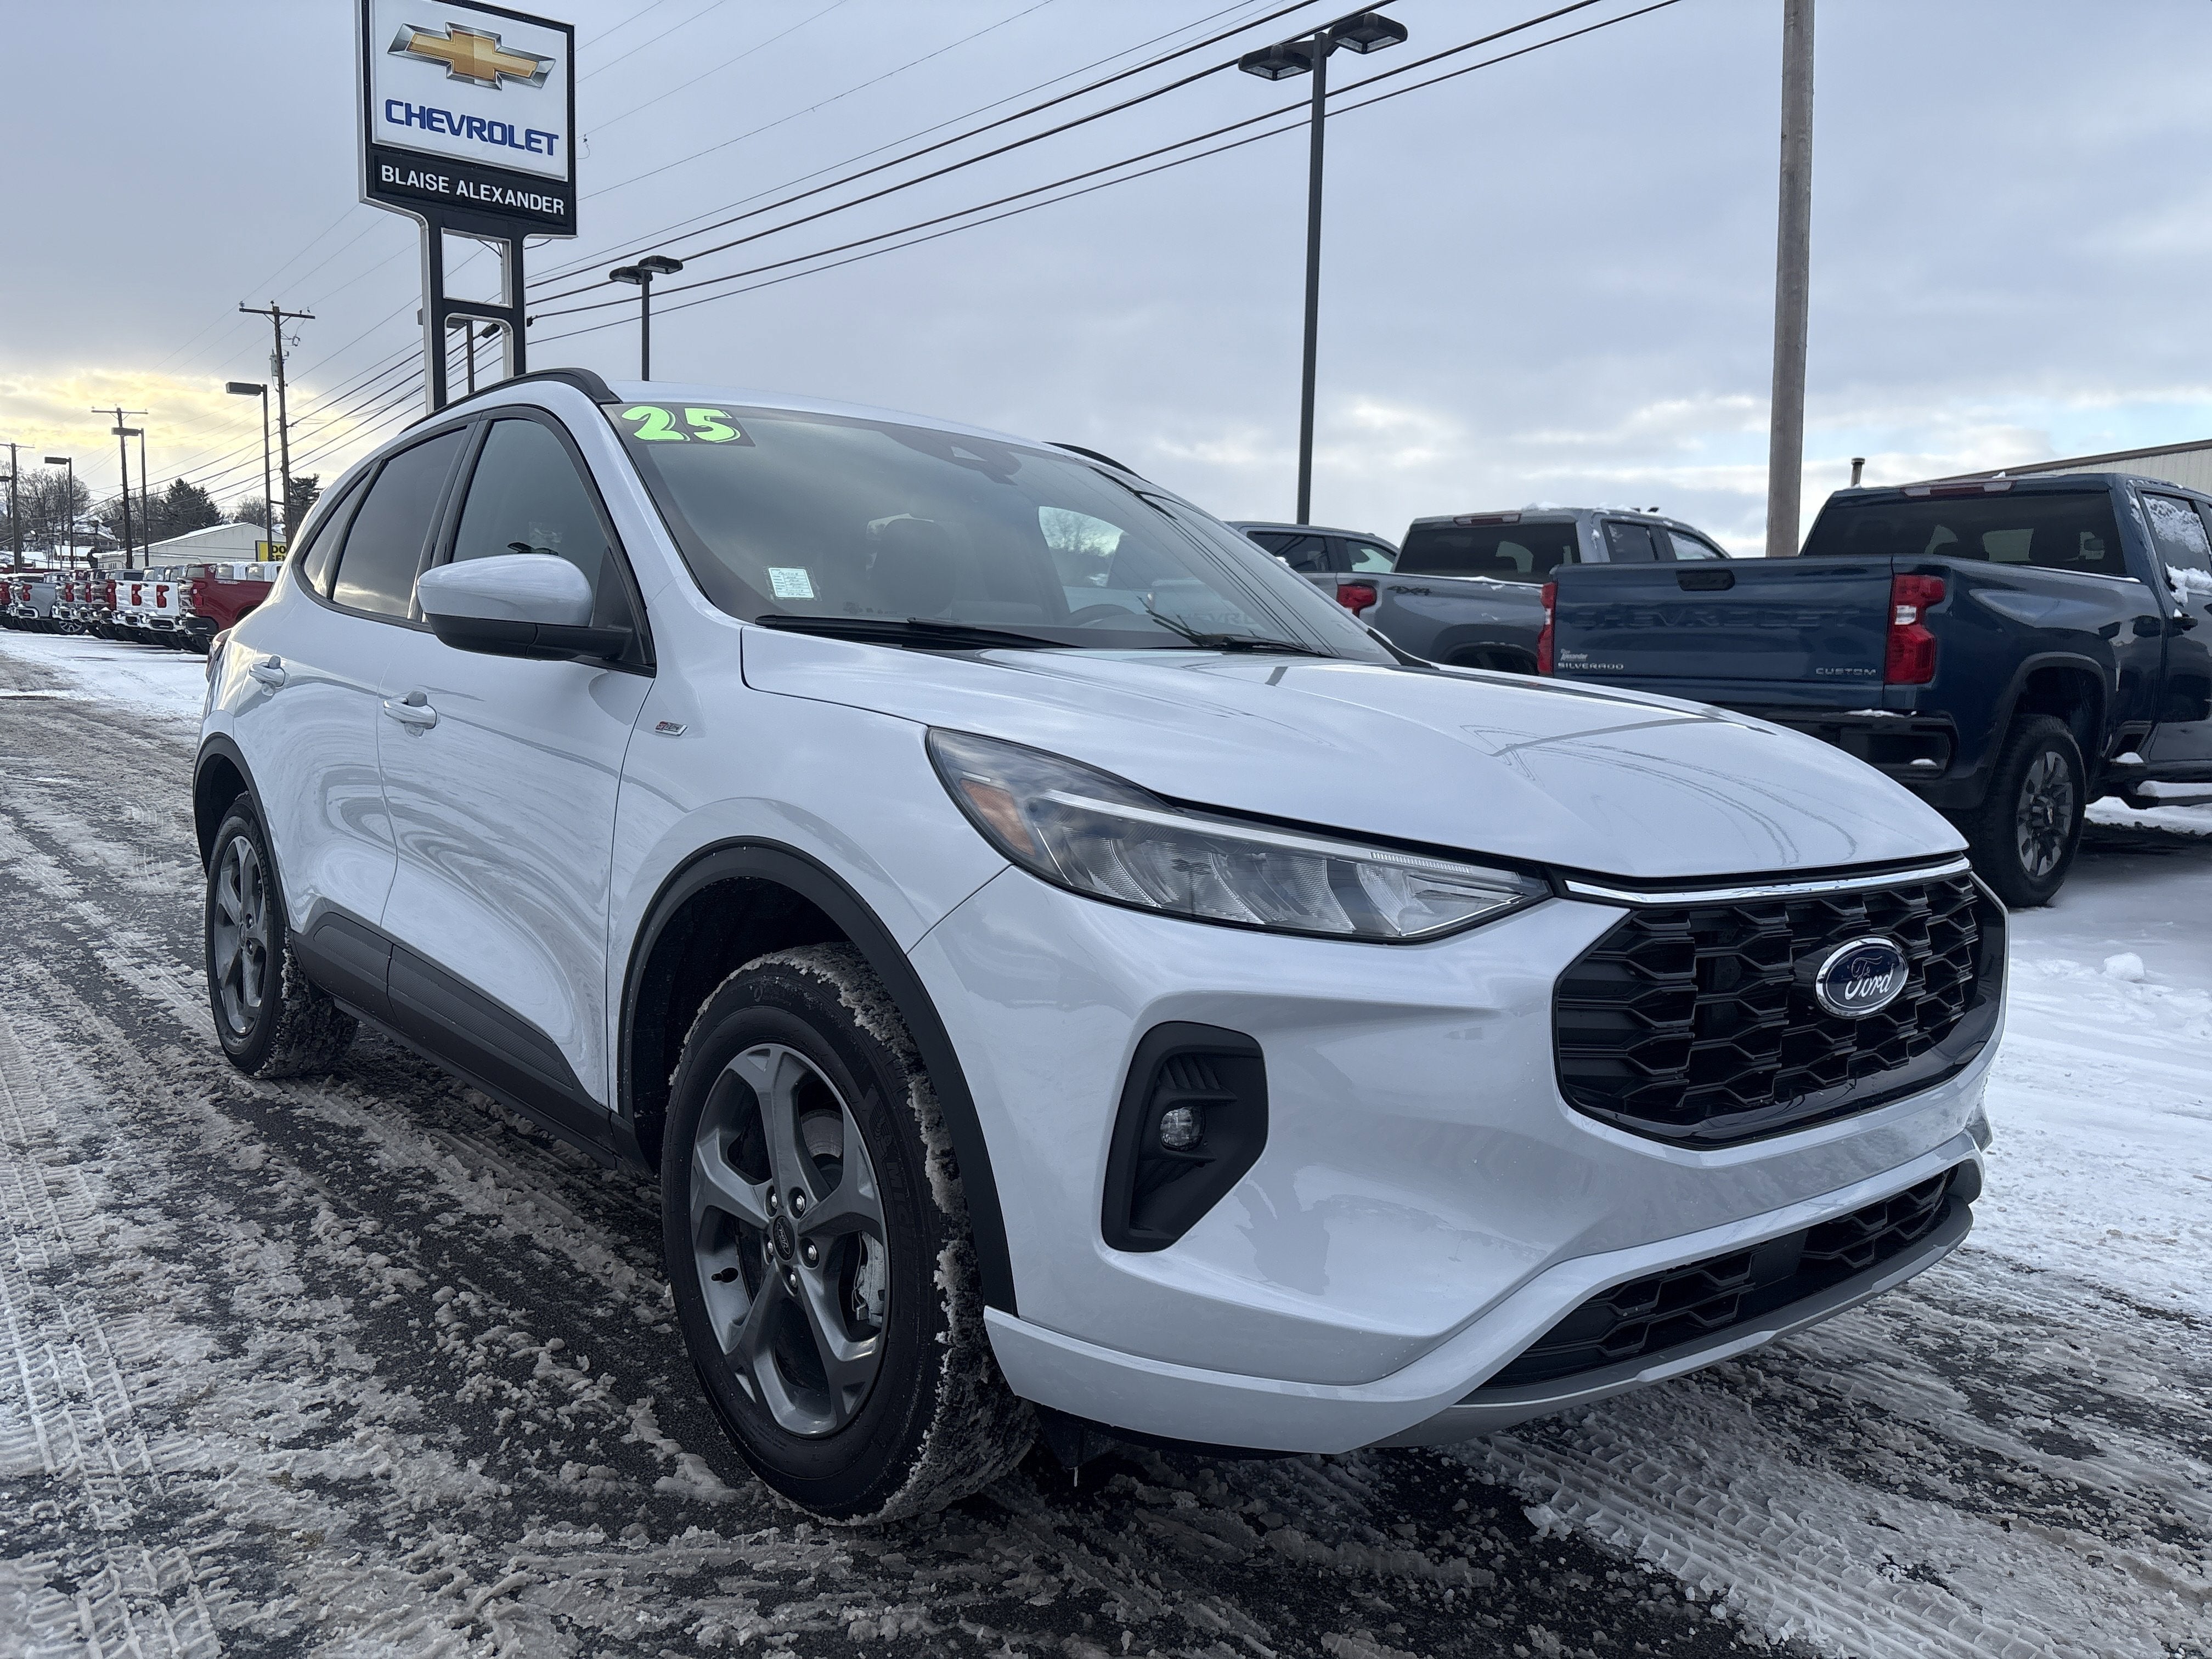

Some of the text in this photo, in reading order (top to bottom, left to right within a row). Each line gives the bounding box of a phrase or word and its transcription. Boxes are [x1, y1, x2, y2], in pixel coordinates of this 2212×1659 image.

[385, 99, 559, 156] CHEVROLET
[381, 165, 565, 215] BLAISE ALEXANDER
[622, 405, 741, 443] 25
[272, 545, 286, 554] DO
[1571, 611, 1860, 628] CHEVROLET
[1815, 667, 1877, 676] CUSTOM
[1844, 956, 1895, 1000] Ford
